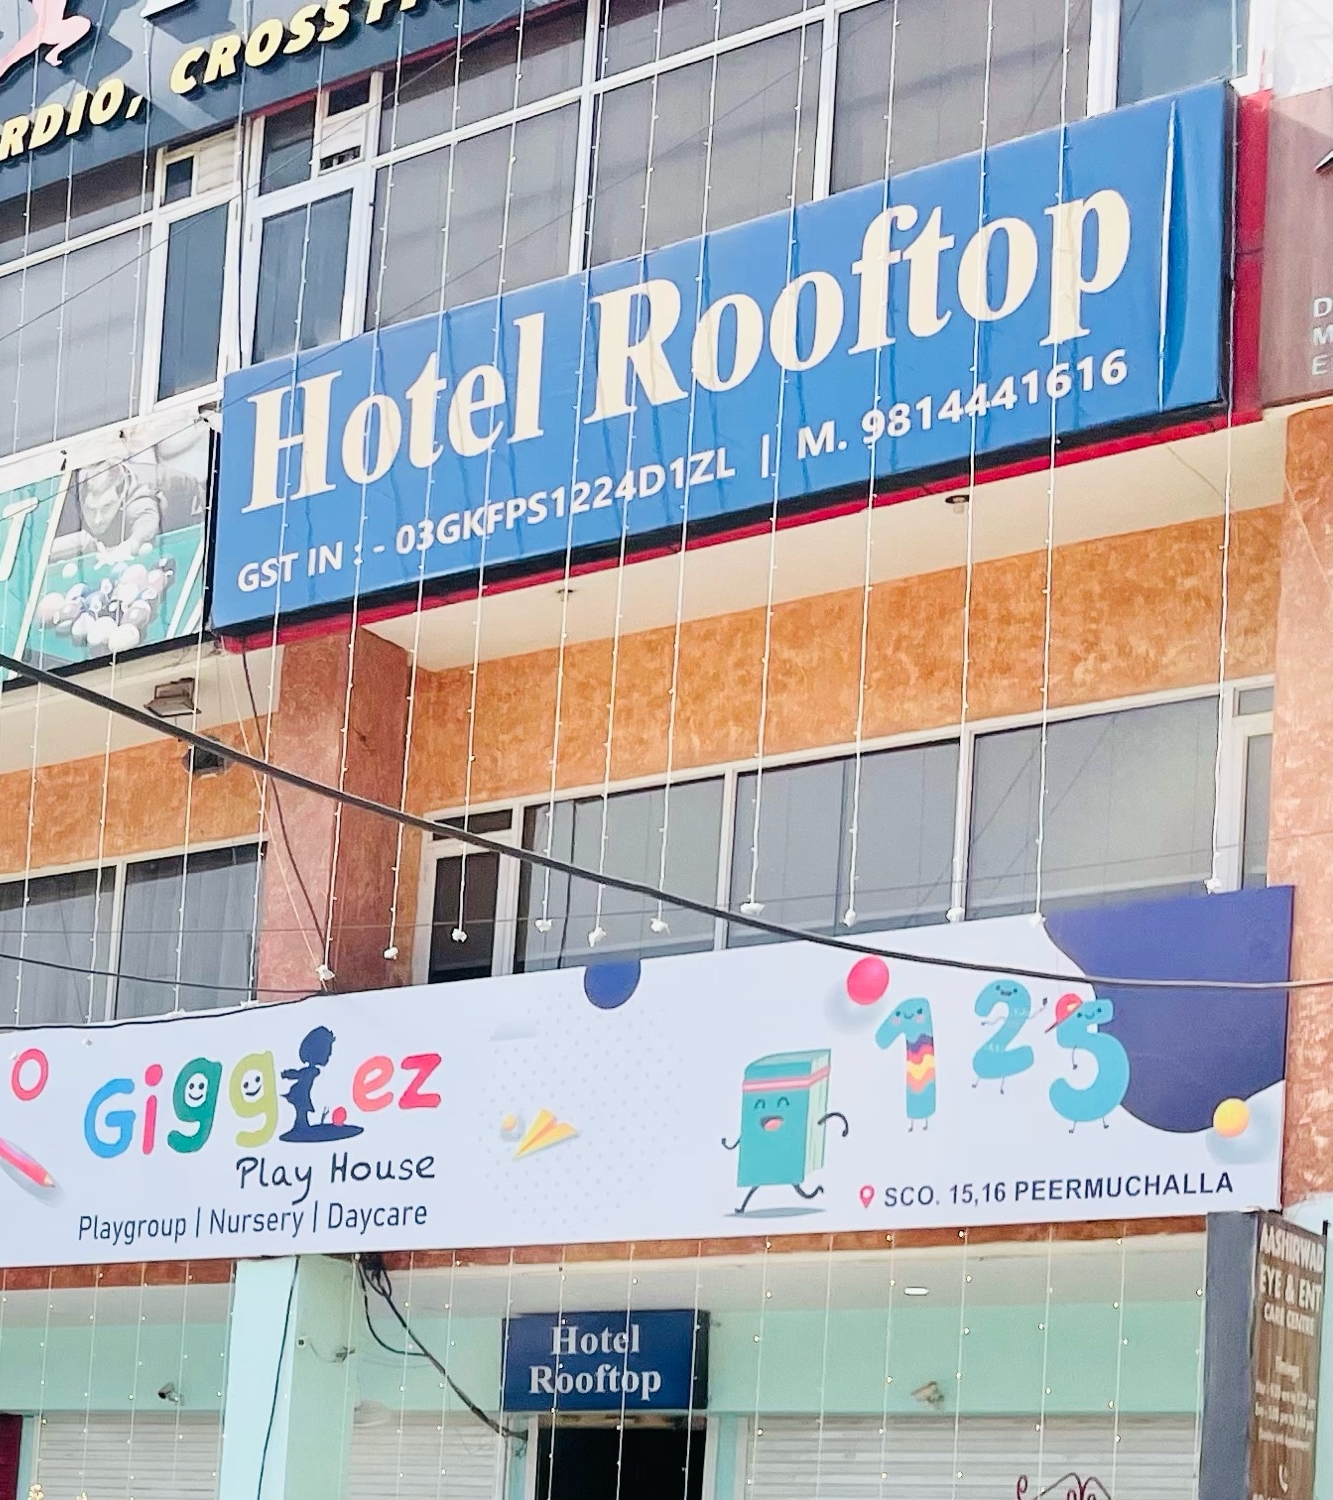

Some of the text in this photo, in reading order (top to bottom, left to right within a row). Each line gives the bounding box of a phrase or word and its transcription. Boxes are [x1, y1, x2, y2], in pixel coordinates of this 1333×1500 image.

[241, 189, 1131, 515] Hotel Rooftop
[238, 552, 297, 592] GST
[307, 541, 343, 577] IN
[797, 425, 849, 460] M.
[862, 348, 1129, 441] 9814441616
[236, 1153, 435, 1205] Play House
[883, 1172, 1234, 1207] SCO. 15,16 PEERMUCHALLA
[79, 1200, 427, 1246] Playgroup Nursery Daycare
[1259, 1262, 1282, 1299] EYE
[1298, 1278, 1322, 1312] ENT
[550, 1324, 640, 1356] Hotel
[529, 1363, 662, 1402] Rooftop
